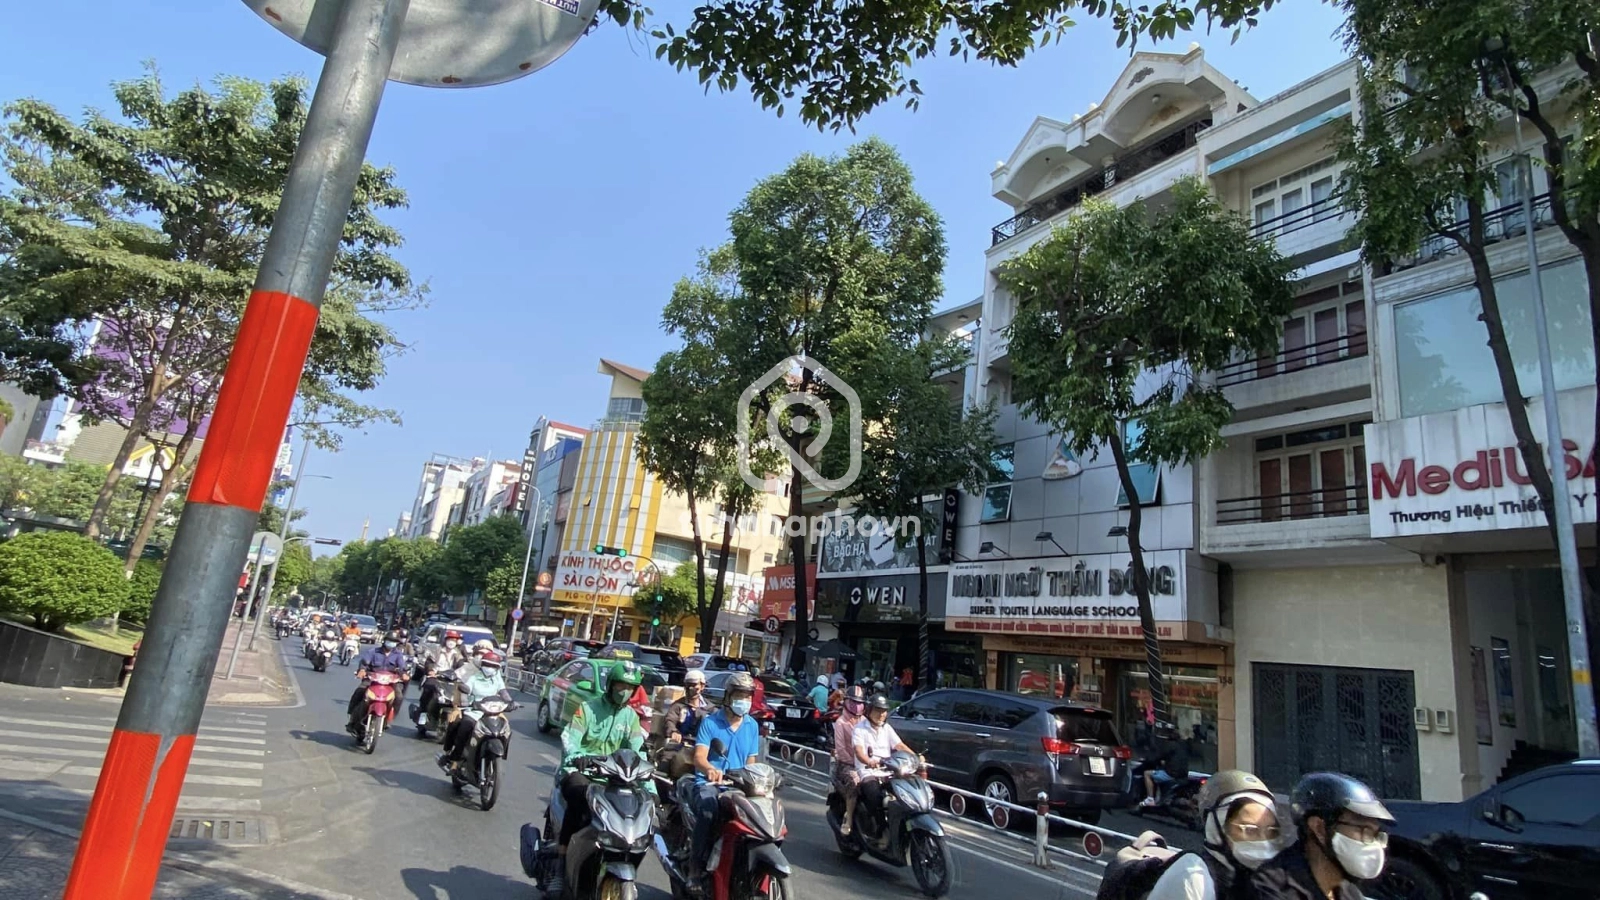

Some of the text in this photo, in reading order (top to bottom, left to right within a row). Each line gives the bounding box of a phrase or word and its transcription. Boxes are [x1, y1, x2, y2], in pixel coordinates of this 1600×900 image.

[516, 463, 533, 511] HOTEL
[1390, 509, 1451, 523] Thương
[1456, 504, 1494, 520] Hiệu
[561, 551, 585, 568] KÍNH
[563, 570, 583, 586] SÀI
[585, 573, 618, 590] GÒN
[851, 586, 905, 605] OWEN
[970, 606, 995, 615] SUPER
[999, 606, 1028, 615] YOUTH
[1032, 606, 1088, 616] LANGUAGE
